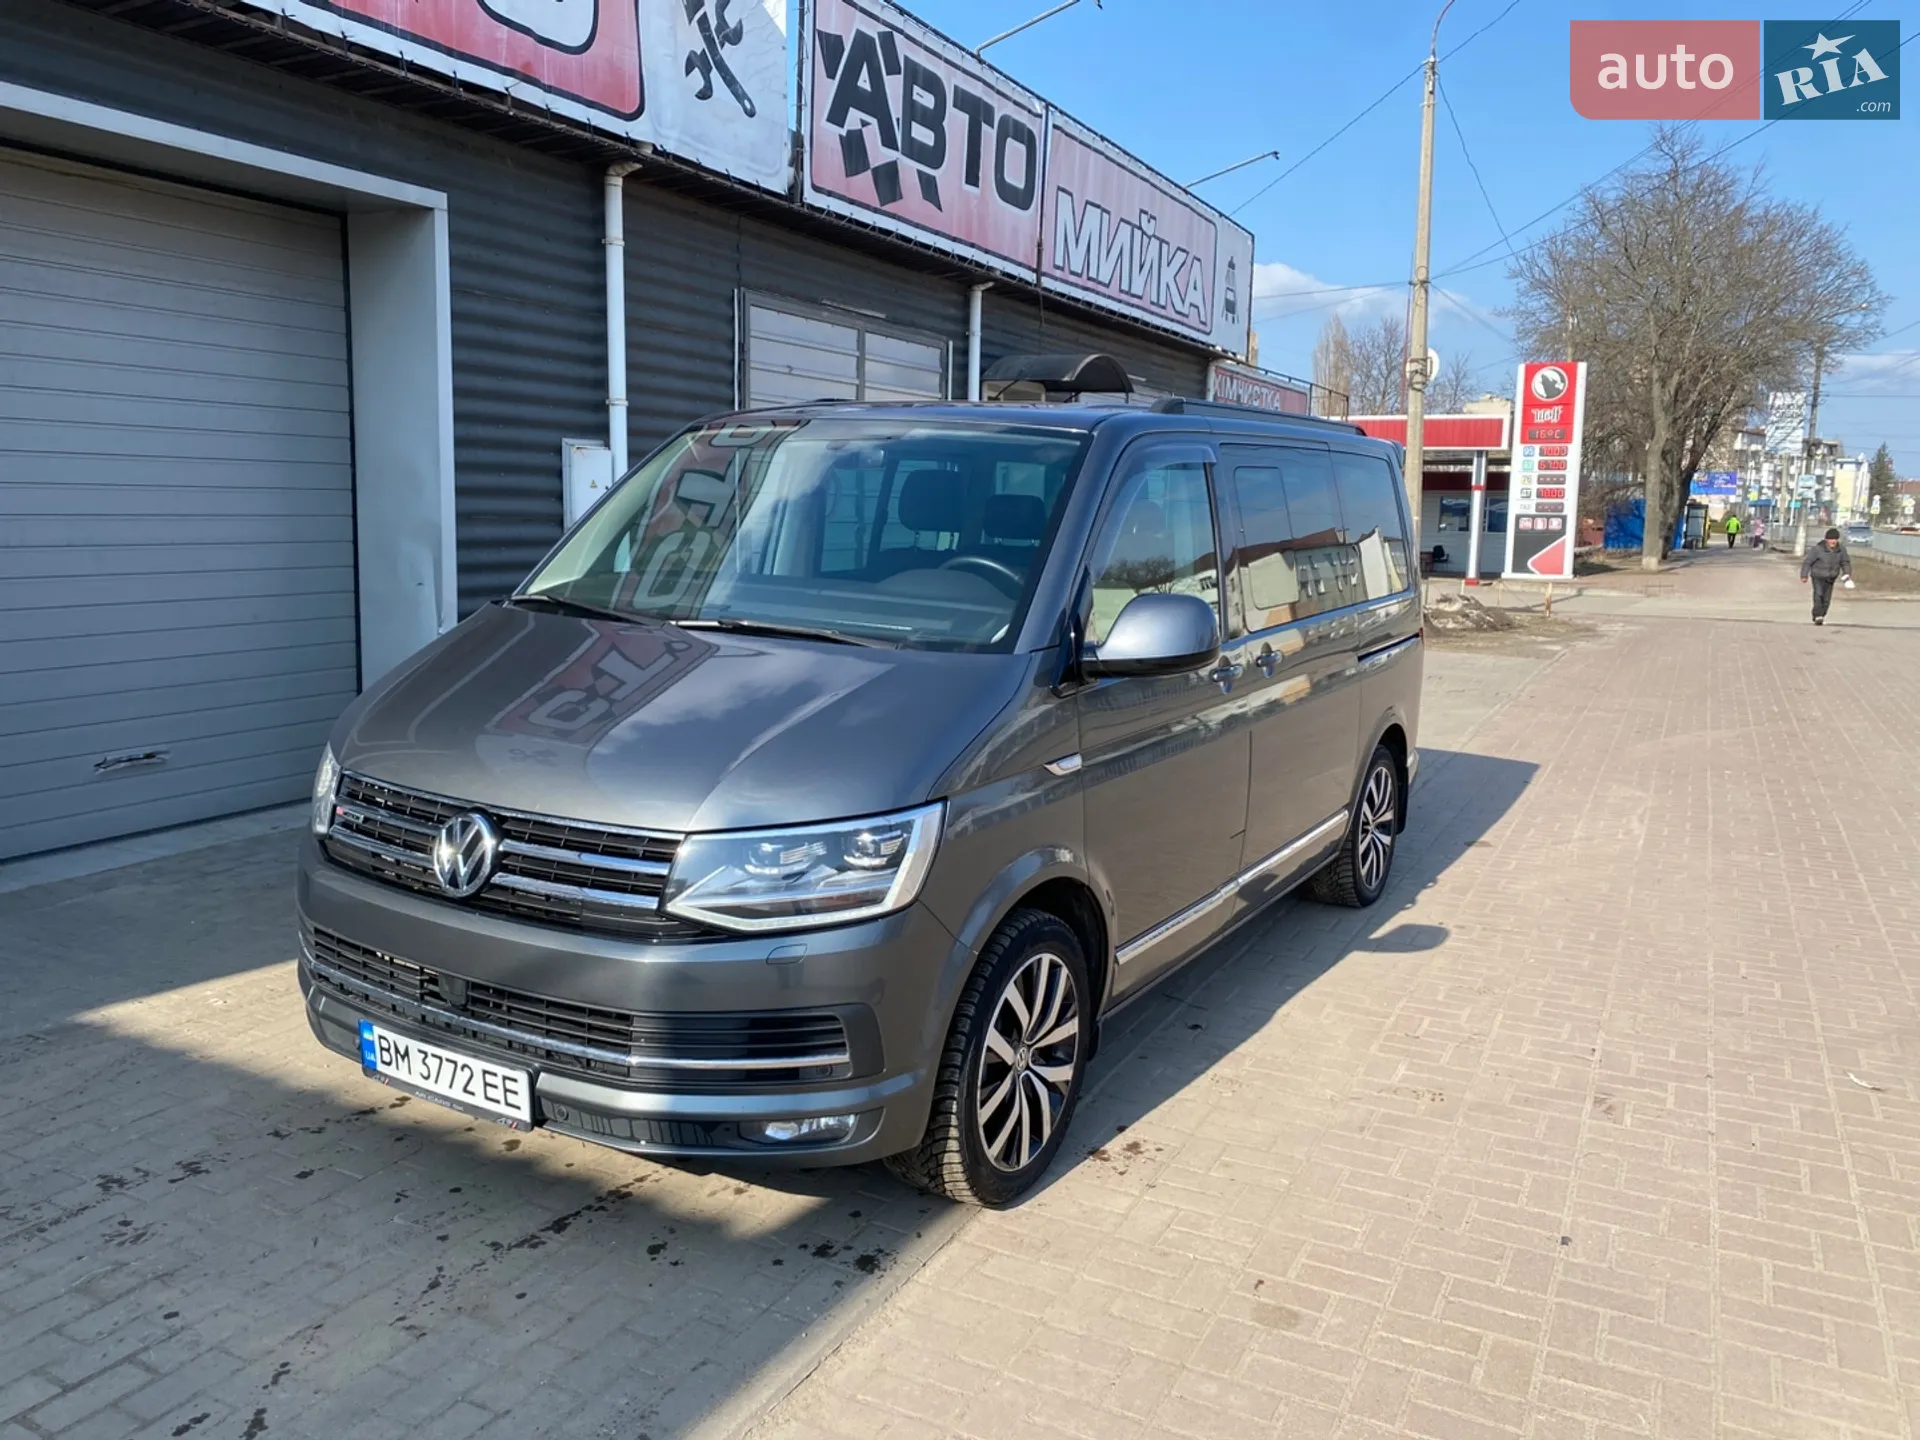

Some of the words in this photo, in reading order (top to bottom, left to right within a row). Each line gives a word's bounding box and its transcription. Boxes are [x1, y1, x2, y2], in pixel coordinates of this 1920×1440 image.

[825, 27, 1038, 211] АВТО
[1053, 185, 1207, 326] МИЙКА
[377, 1034, 412, 1076] BM
[417, 1049, 476, 1097] 3772
[481, 1068, 522, 1111] EE
